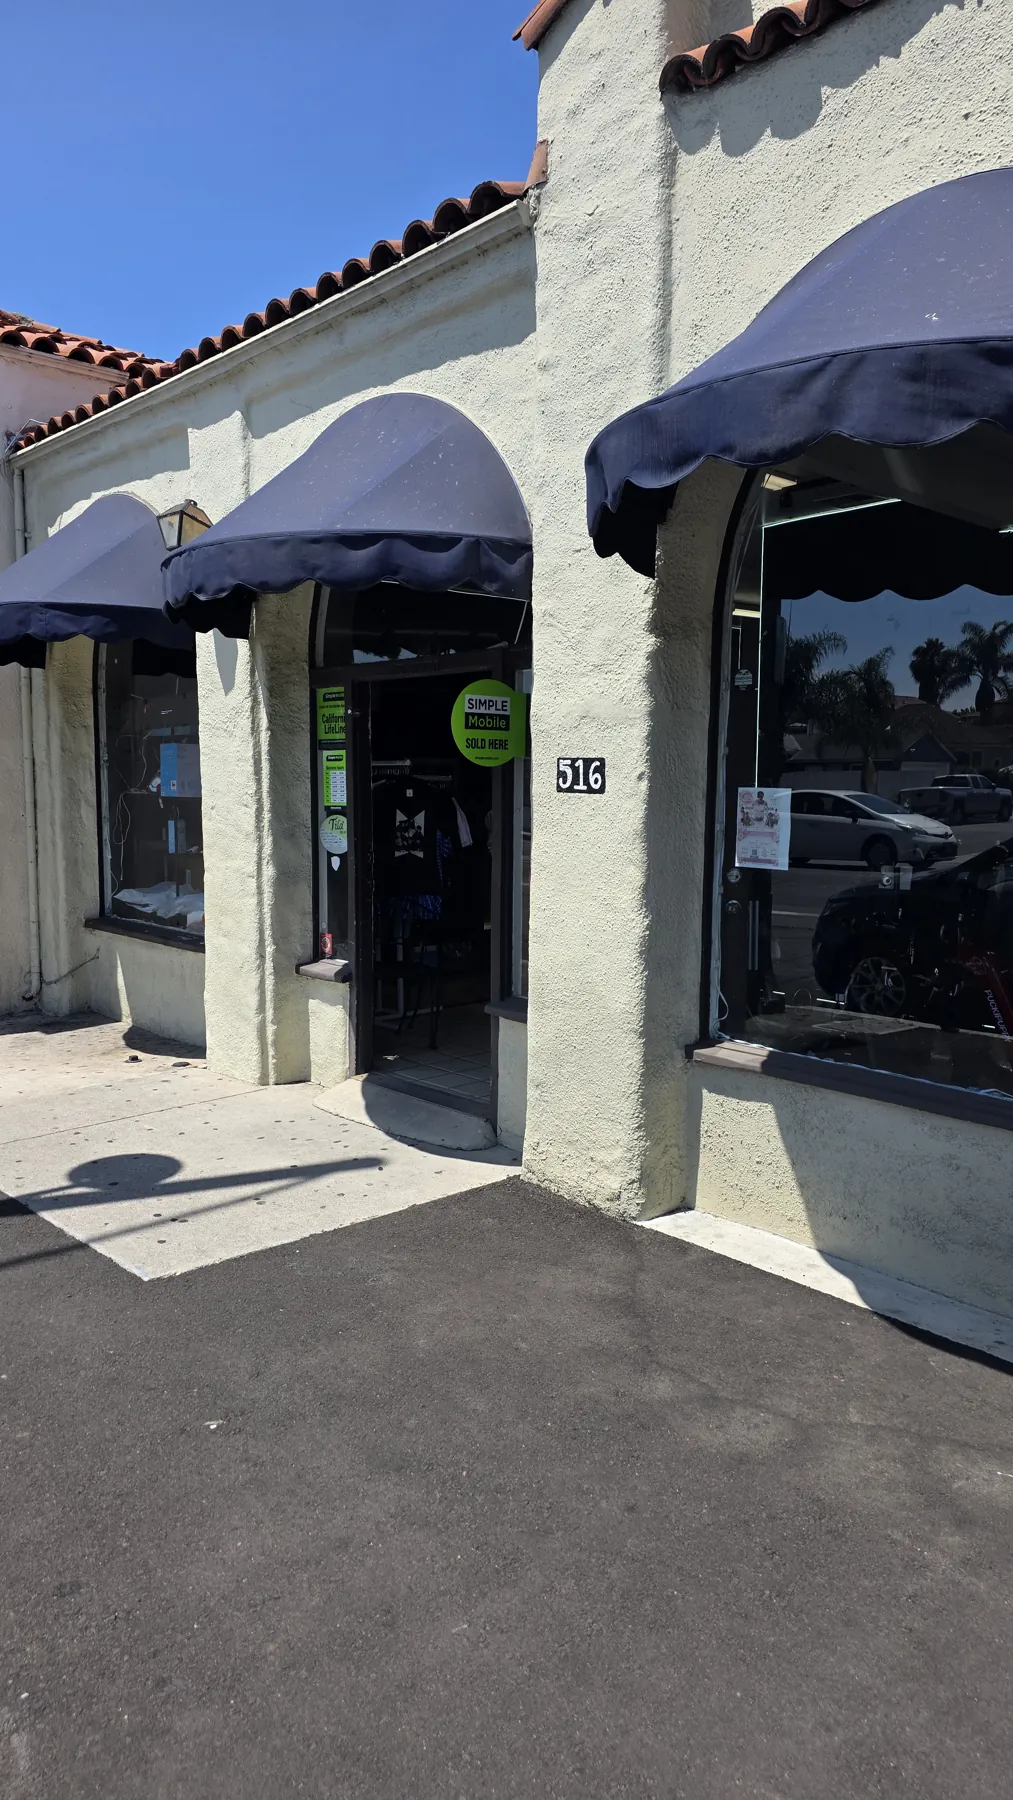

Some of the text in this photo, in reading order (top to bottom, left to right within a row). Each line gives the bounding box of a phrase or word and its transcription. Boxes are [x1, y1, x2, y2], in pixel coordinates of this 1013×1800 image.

[467, 698, 508, 712] SIMPLE
[321, 713, 346, 724] Californi
[468, 715, 507, 729] Mobile
[465, 737, 509, 751] SOLD HERE
[558, 759, 602, 790] 516
